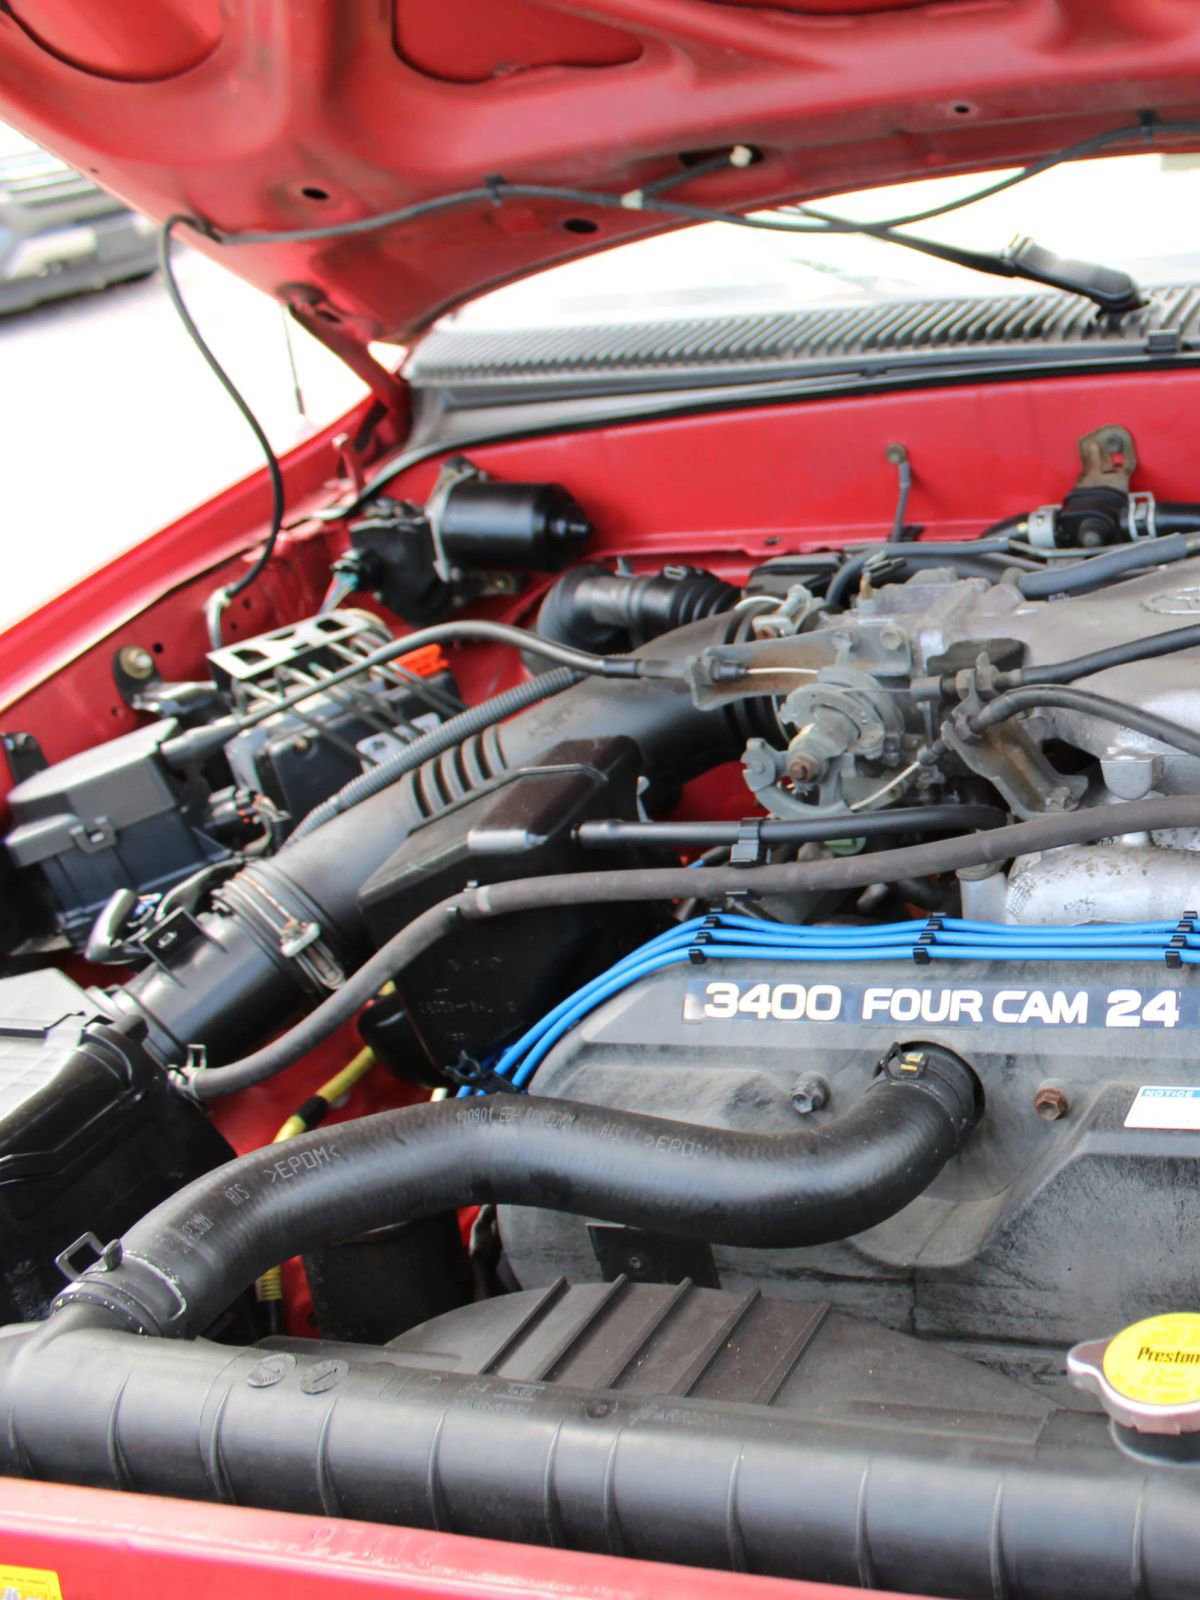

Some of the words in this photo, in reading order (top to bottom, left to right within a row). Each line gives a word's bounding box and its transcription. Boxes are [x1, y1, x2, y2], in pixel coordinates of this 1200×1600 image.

[704, 982, 842, 1021] 3400
[862, 988, 984, 1022] FOUR
[992, 990, 1089, 1024] CAM
[1105, 988, 1181, 1028] 24
[1144, 1089, 1194, 1098] NOTICE
